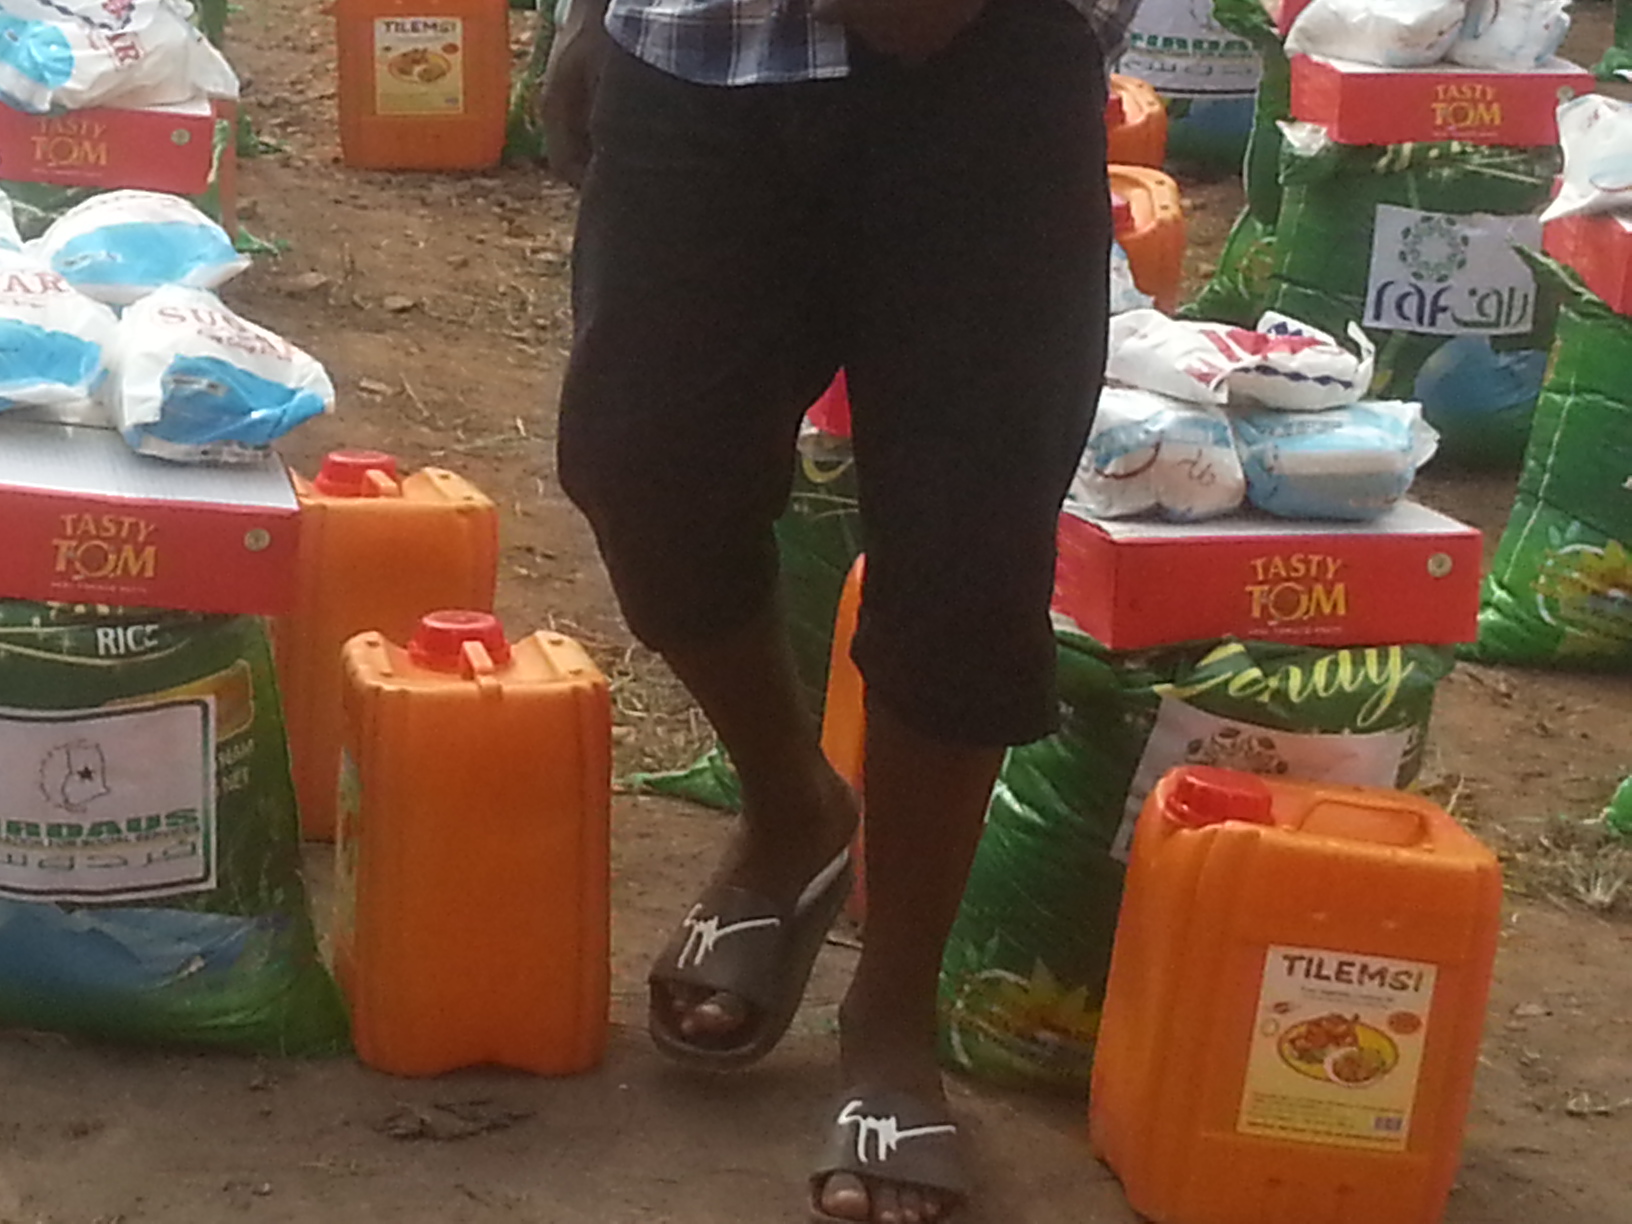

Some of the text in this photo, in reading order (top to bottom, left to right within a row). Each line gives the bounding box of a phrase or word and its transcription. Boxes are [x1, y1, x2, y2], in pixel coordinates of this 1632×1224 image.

[1435, 83, 1498, 102] TASTY
[1430, 102, 1503, 127] TOM
[30, 136, 107, 166] TOM
[60, 513, 156, 543] TASTY
[51, 538, 157, 581] TOM
[1250, 552, 1343, 581] TASTY
[1244, 582, 1347, 622] TOM
[96, 624, 160, 657] RICE
[1281, 953, 1425, 993] TILEMSI
